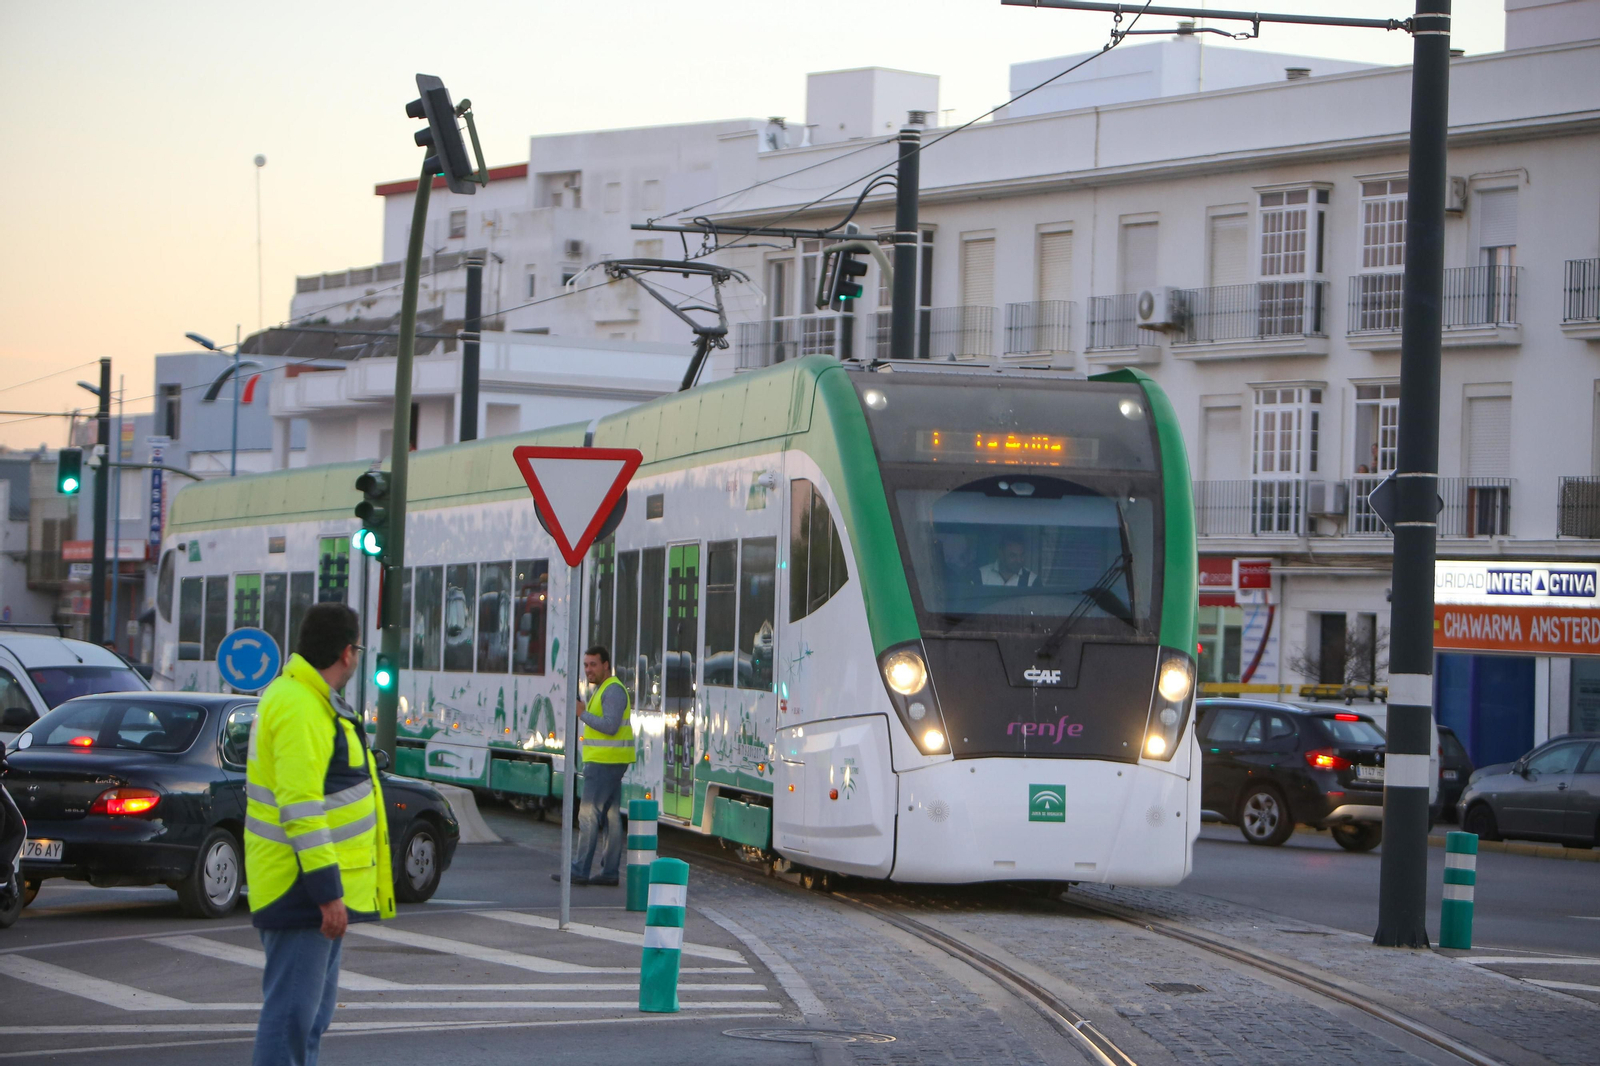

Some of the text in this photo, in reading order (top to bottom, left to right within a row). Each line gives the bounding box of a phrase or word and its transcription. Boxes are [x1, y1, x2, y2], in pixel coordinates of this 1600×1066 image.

[1444, 612, 1523, 641] CHAWARMA
[1023, 669, 1061, 684] CAF
[1006, 715, 1084, 744] renfe
[45, 843, 61, 858] AY
